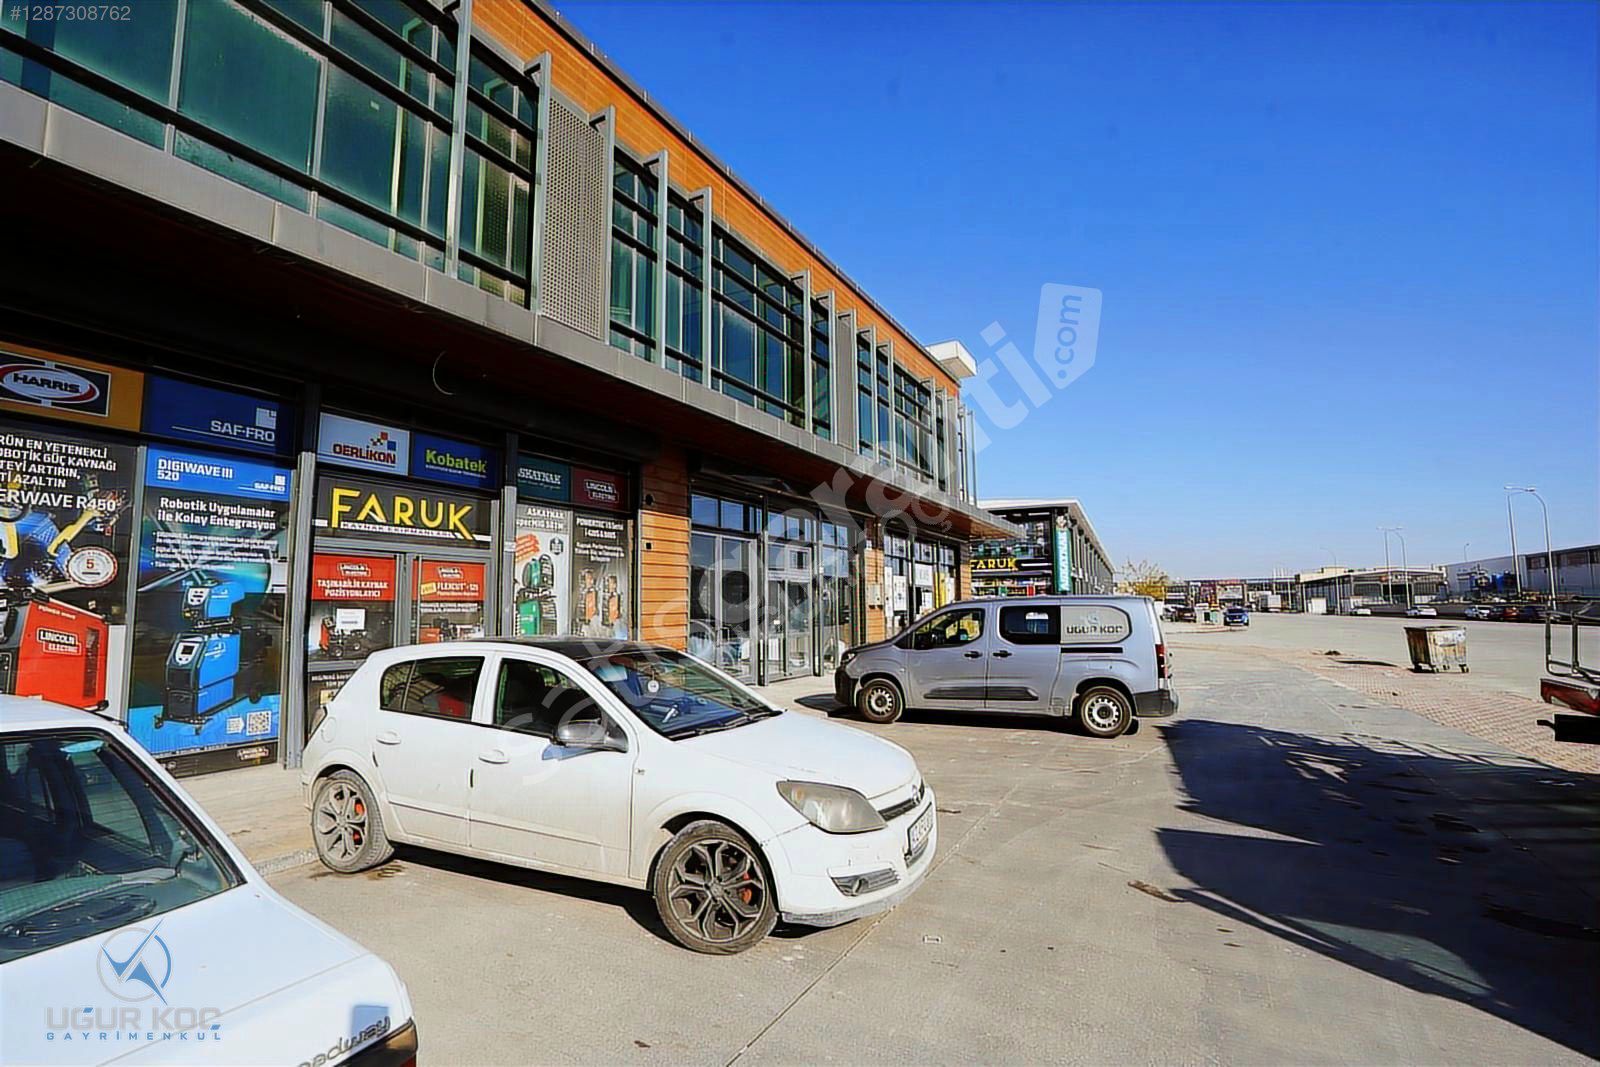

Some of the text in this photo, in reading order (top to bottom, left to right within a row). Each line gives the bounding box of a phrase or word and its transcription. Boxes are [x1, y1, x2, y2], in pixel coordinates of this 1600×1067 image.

[13, 373, 82, 394] HARRIS
[210, 420, 275, 442] SAF-FRO
[26, 439, 43, 450] EN
[44, 442, 108, 459] YETENEKLİ
[43, 453, 67, 467] GÜÇ
[68, 456, 117, 471] KAYNAĞI
[425, 449, 487, 473] Kobatek
[28, 463, 81, 480] ARTIRIN,
[157, 469, 180, 481] 520
[517, 467, 561, 485] SKAYNAK
[14, 474, 67, 488] AZALTIN
[160, 497, 276, 518] Robotik Uygulamalar
[331, 488, 474, 541] FARUK
[157, 509, 276, 531] ile Kolay Entegrasyon
[86, 559, 95, 569] 5
[970, 558, 1018, 572] FARUK
[40, 631, 75, 645] LINCOLN
